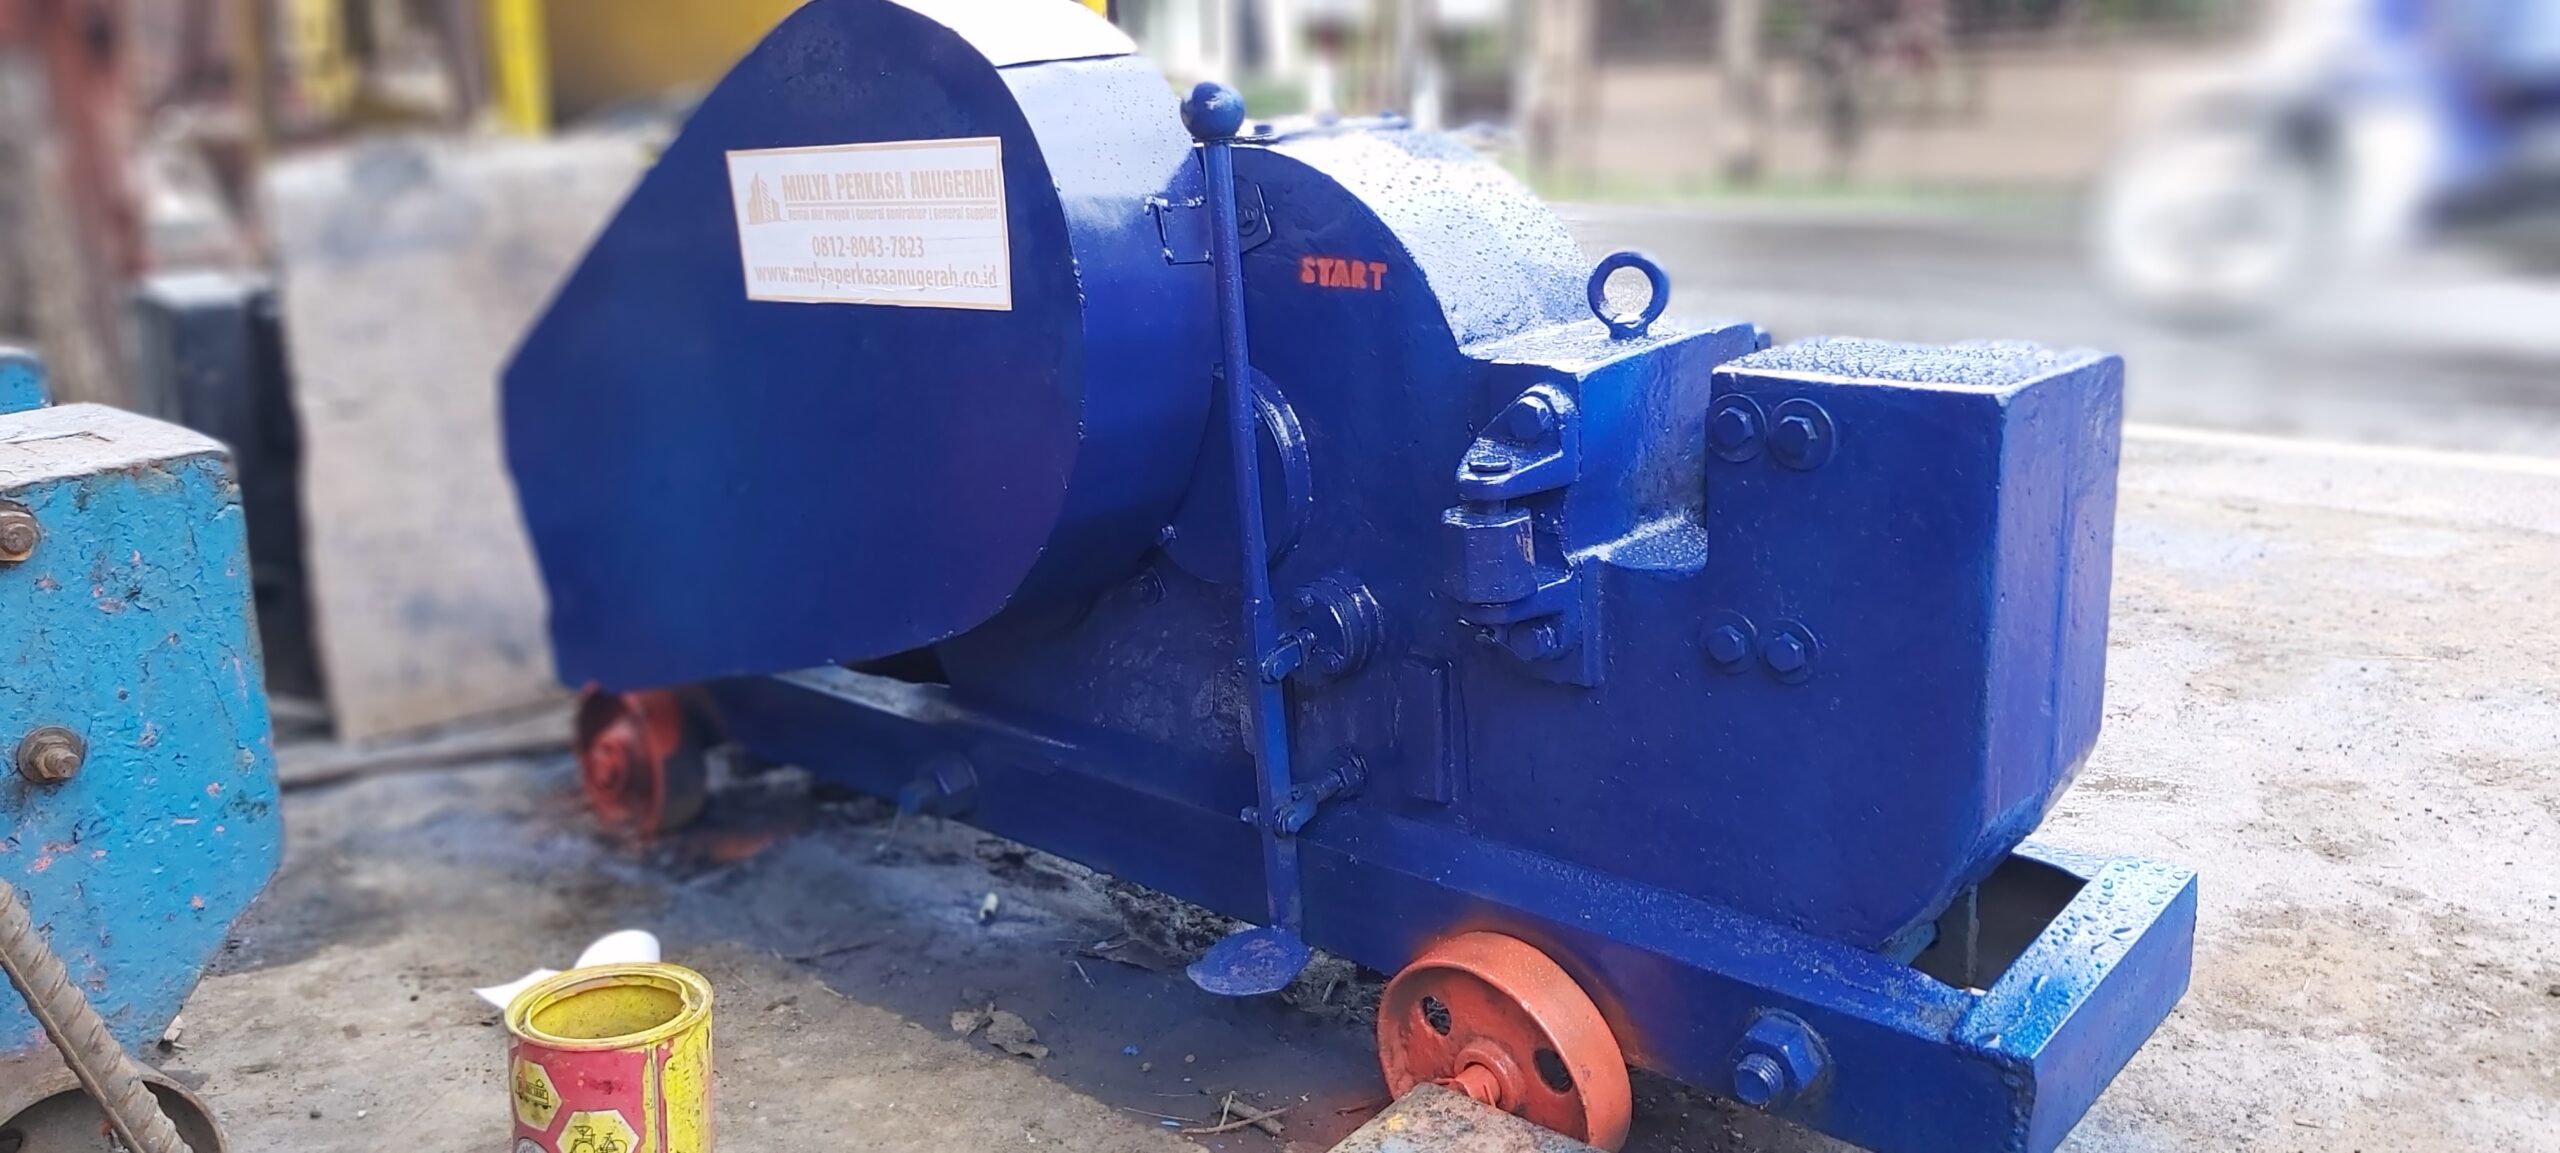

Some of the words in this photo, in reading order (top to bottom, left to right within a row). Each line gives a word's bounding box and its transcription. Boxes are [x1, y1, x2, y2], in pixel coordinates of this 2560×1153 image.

[781, 174, 832, 201] MULYA
[835, 171, 905, 200] PERKASA
[911, 168, 997, 199] ANUGERAH
[812, 235, 925, 259] 0812-8043-7823
[754, 261, 998, 292] www.mulyaperkasaanugerah.co.id
[1299, 255, 1388, 292] START
